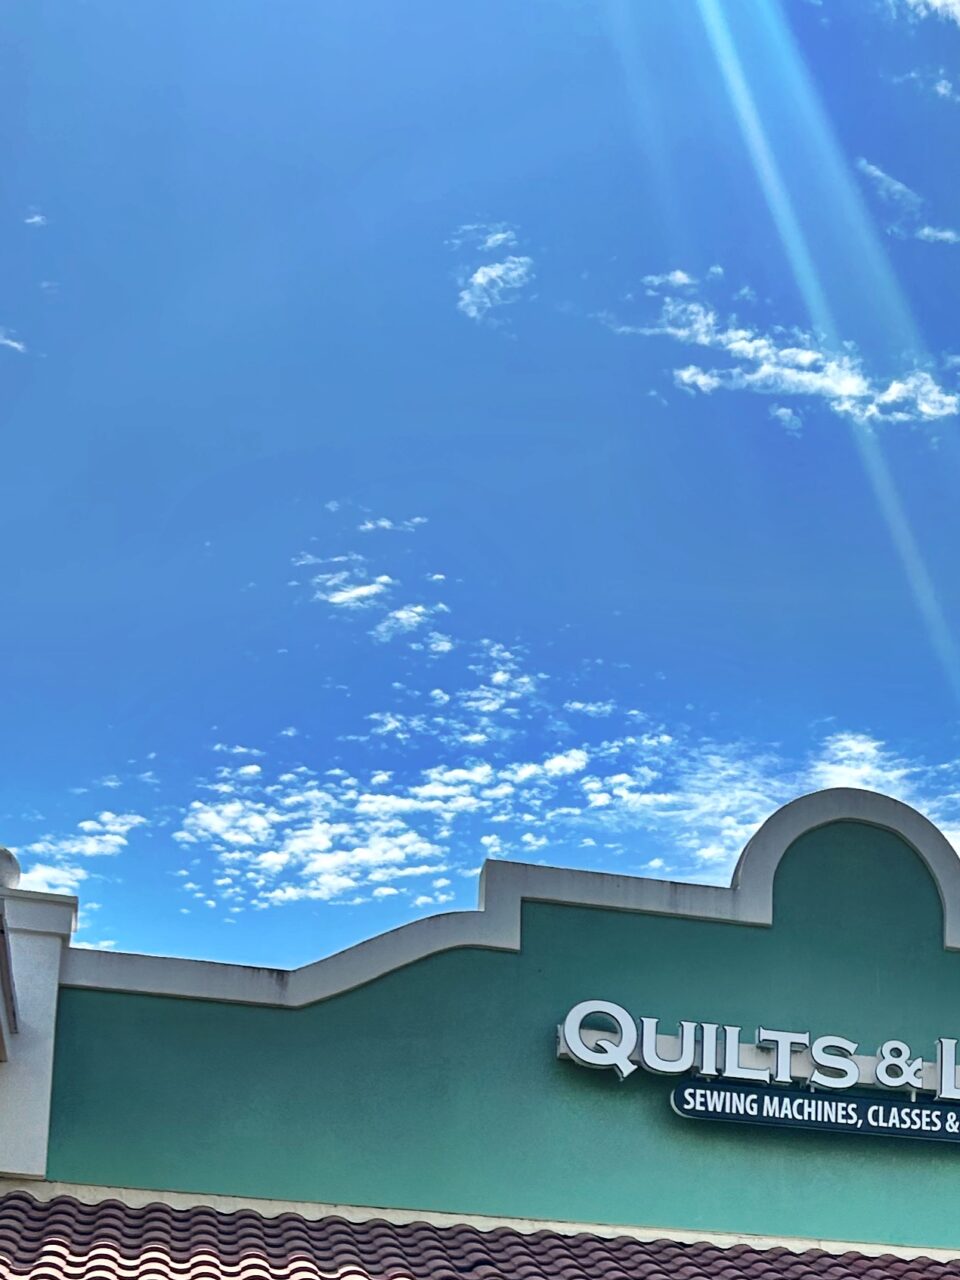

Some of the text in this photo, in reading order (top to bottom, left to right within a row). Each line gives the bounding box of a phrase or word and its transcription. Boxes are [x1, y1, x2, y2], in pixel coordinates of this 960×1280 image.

[564, 999, 859, 1090] QUILTS
[876, 1039, 923, 1088] &
[683, 1087, 759, 1118] SEWING
[762, 1094, 863, 1129] MACHINES,
[867, 1104, 942, 1131] CLASSES
[945, 1112, 960, 1134] &
